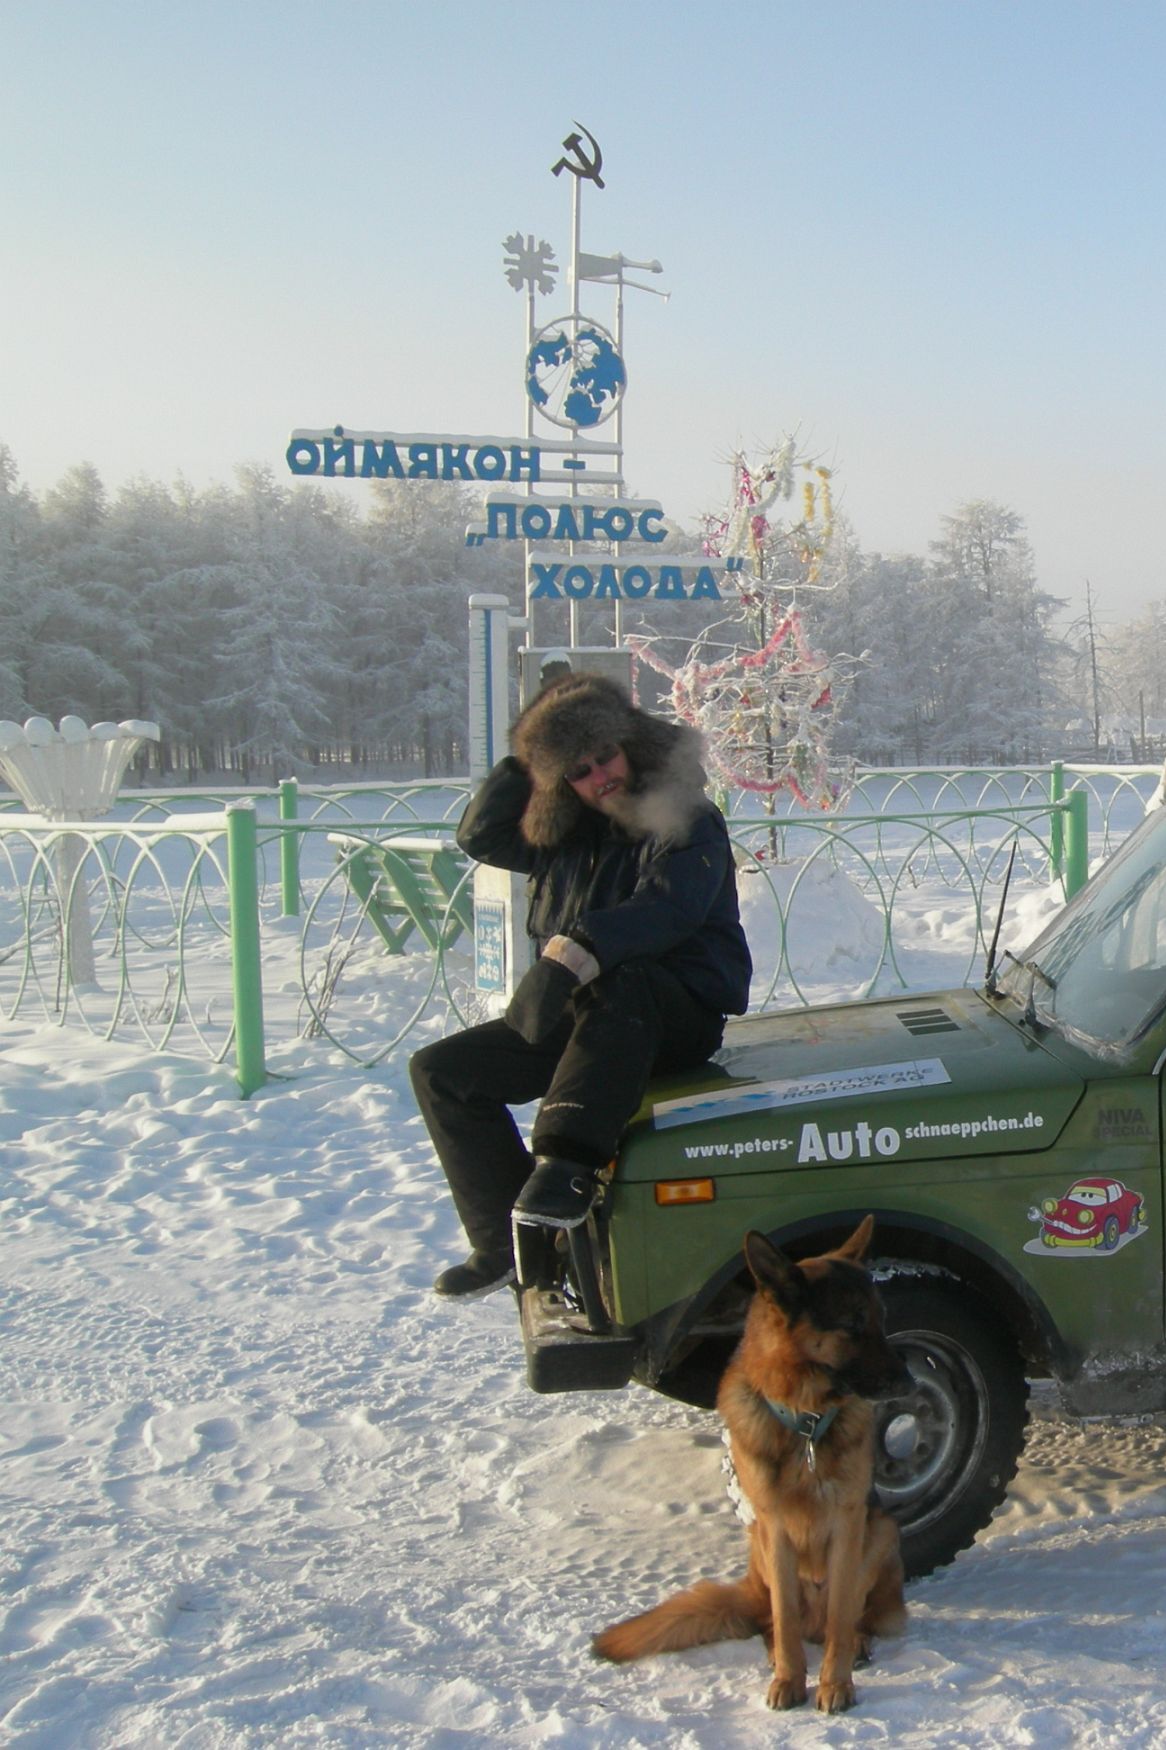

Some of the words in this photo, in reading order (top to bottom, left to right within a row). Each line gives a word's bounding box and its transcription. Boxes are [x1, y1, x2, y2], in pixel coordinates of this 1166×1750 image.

[286, 425, 541, 483] ОЙМЯКОН
[797, 1121, 901, 1164] Auto
[904, 1112, 1045, 1140] schnaeppchen.de
[1098, 1108, 1146, 1126] NIVA
